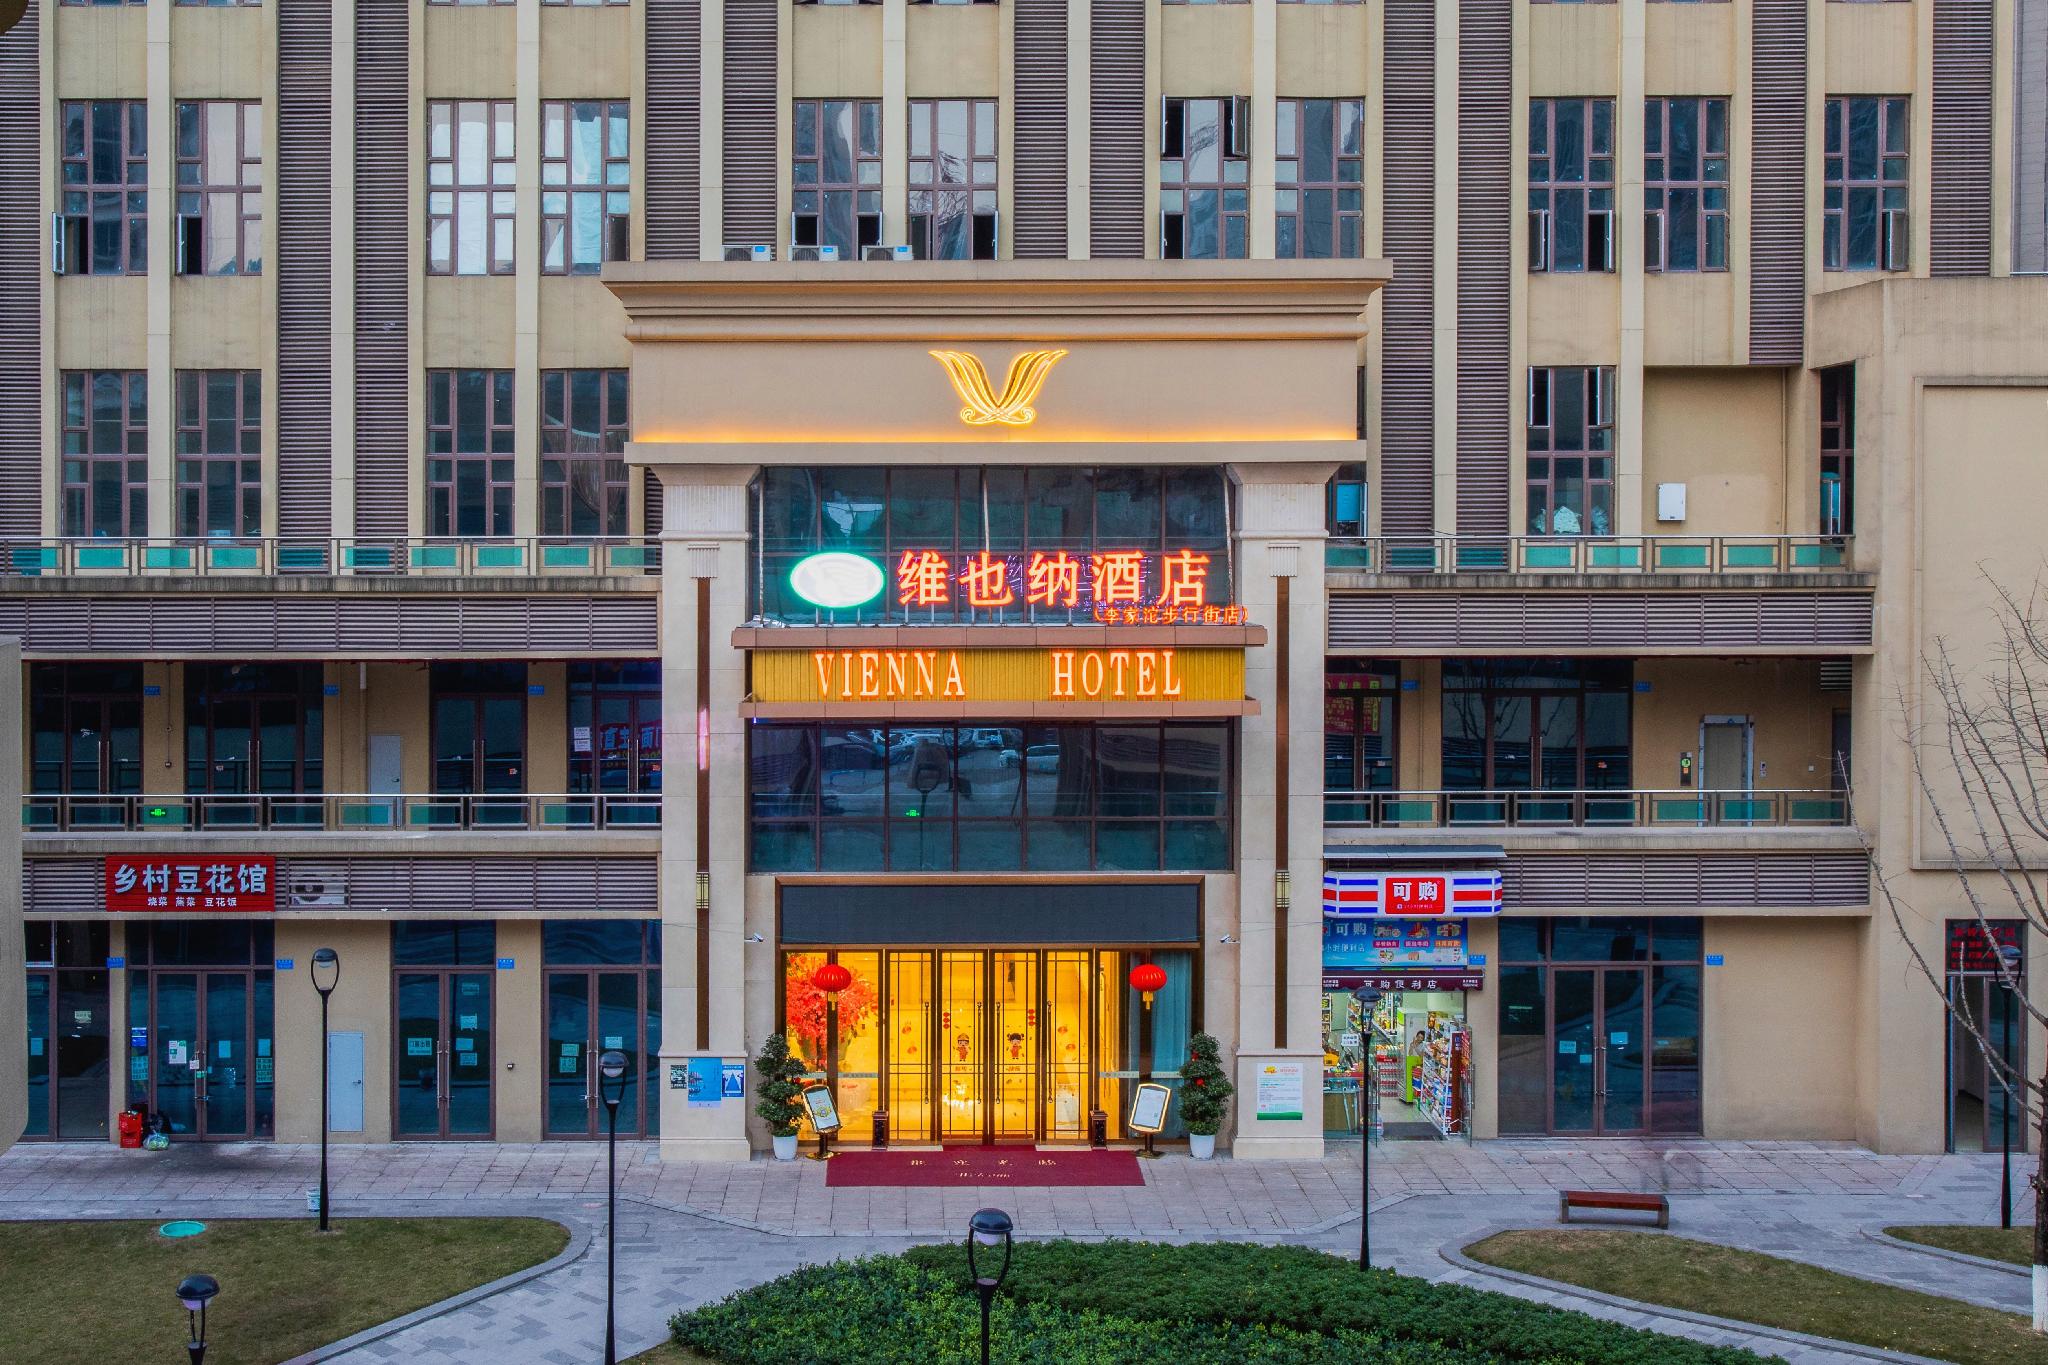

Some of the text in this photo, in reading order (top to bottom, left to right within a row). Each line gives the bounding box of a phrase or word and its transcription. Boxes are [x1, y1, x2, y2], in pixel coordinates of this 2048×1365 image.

[897, 549, 1211, 606] 维也纳酒店
[814, 651, 1182, 697] VIENNA HOTEL
[114, 863, 267, 894] 乡村豆花馆
[1392, 881, 1438, 902] 可购
